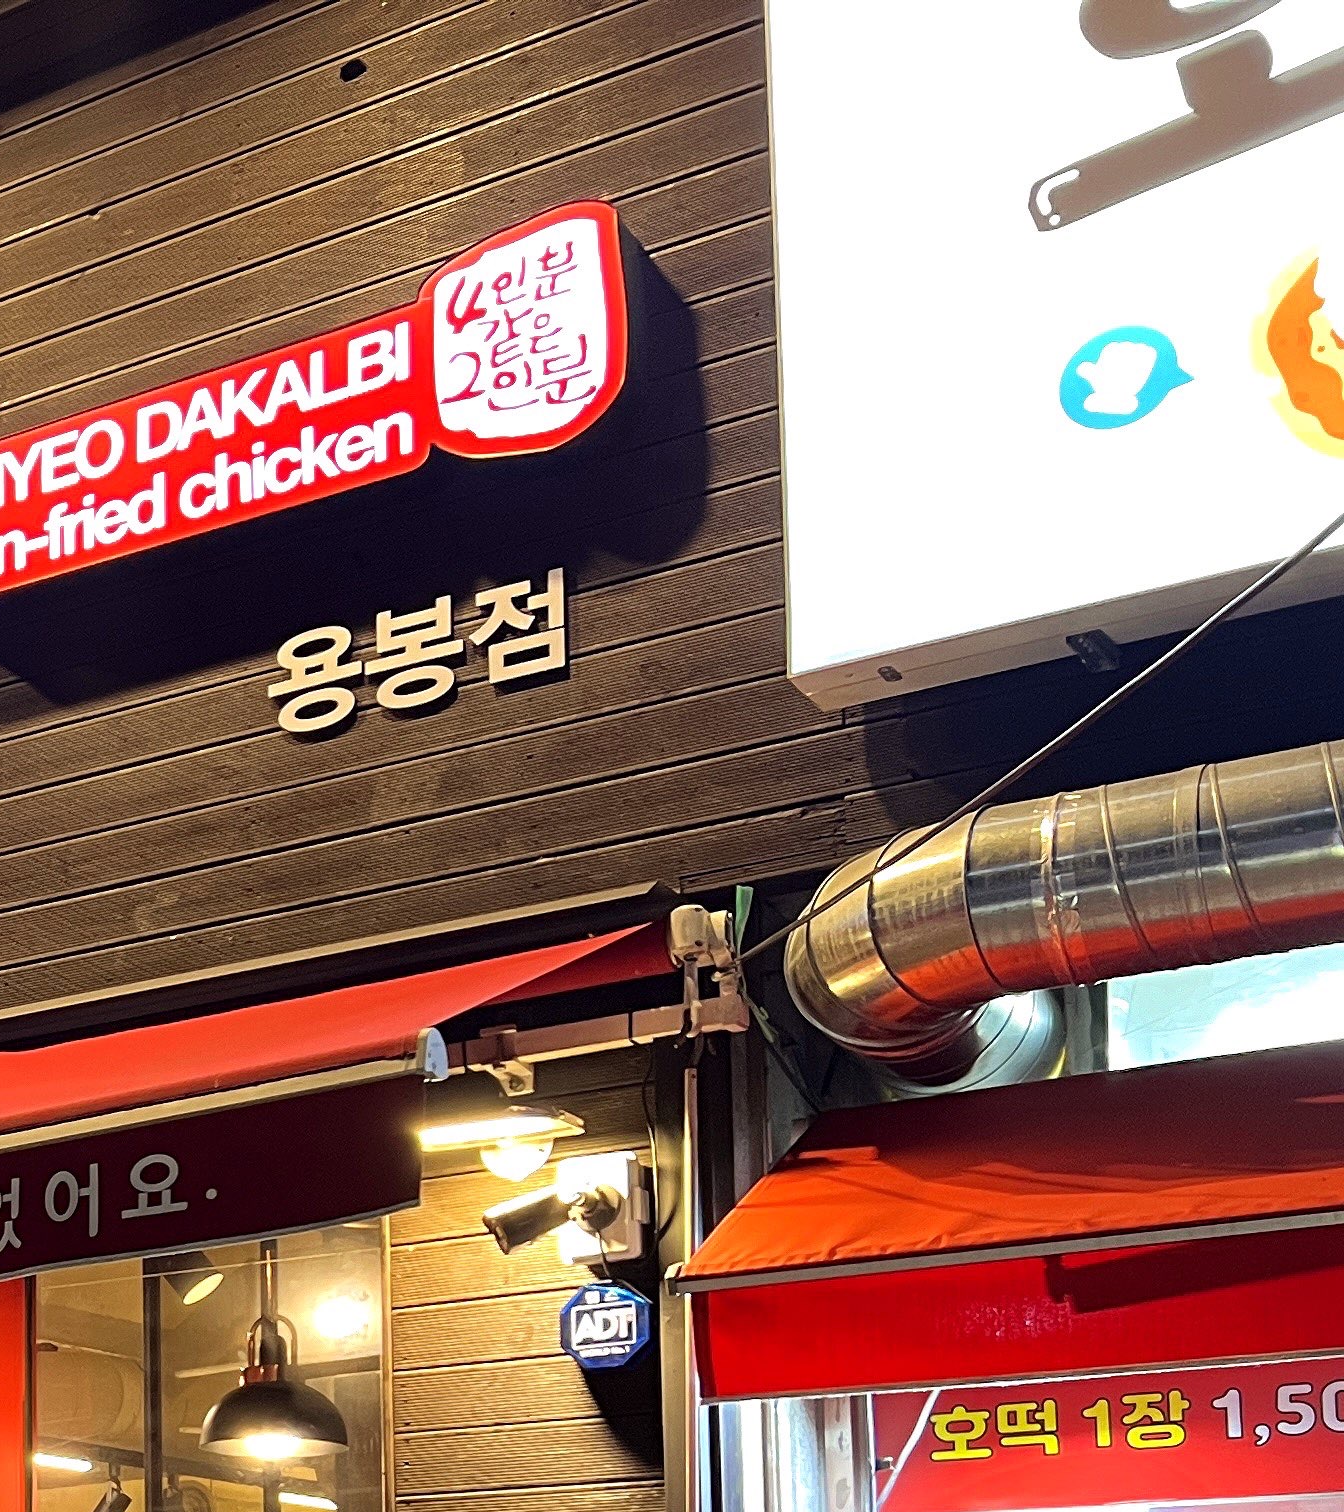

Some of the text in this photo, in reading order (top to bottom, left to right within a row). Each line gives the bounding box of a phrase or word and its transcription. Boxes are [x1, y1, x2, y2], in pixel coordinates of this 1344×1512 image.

[446, 241, 578, 334] 4인분
[477, 308, 562, 368] 같은
[135, 322, 411, 465] DAKALBI
[179, 412, 414, 521] chicken
[268, 568, 570, 734] 용봉점
[575, 1307, 633, 1345] ADT
[930, 1400, 1059, 1461] 호떡
[1083, 1390, 1189, 1449] 1장
